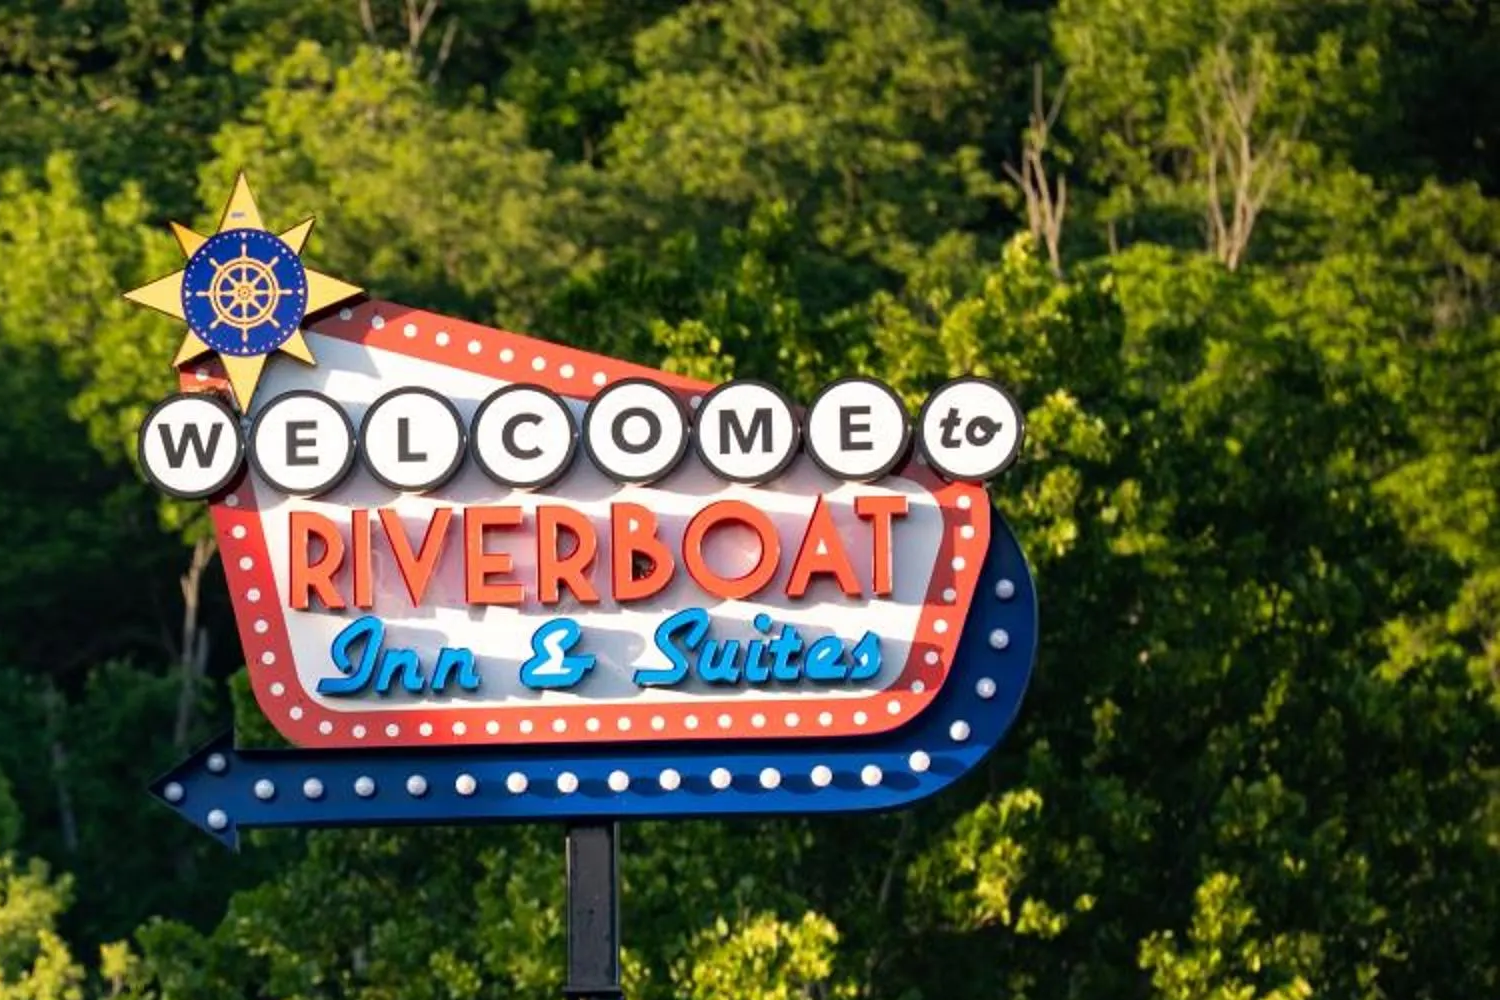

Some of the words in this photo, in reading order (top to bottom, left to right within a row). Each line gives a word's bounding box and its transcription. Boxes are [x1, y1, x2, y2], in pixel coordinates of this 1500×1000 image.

[158, 405, 874, 468] WELCOME
[939, 407, 1002, 449] to
[289, 493, 909, 609] RIVERBOAT
[316, 615, 482, 693] Inn
[520, 617, 596, 689] &
[632, 607, 881, 686] Suites
